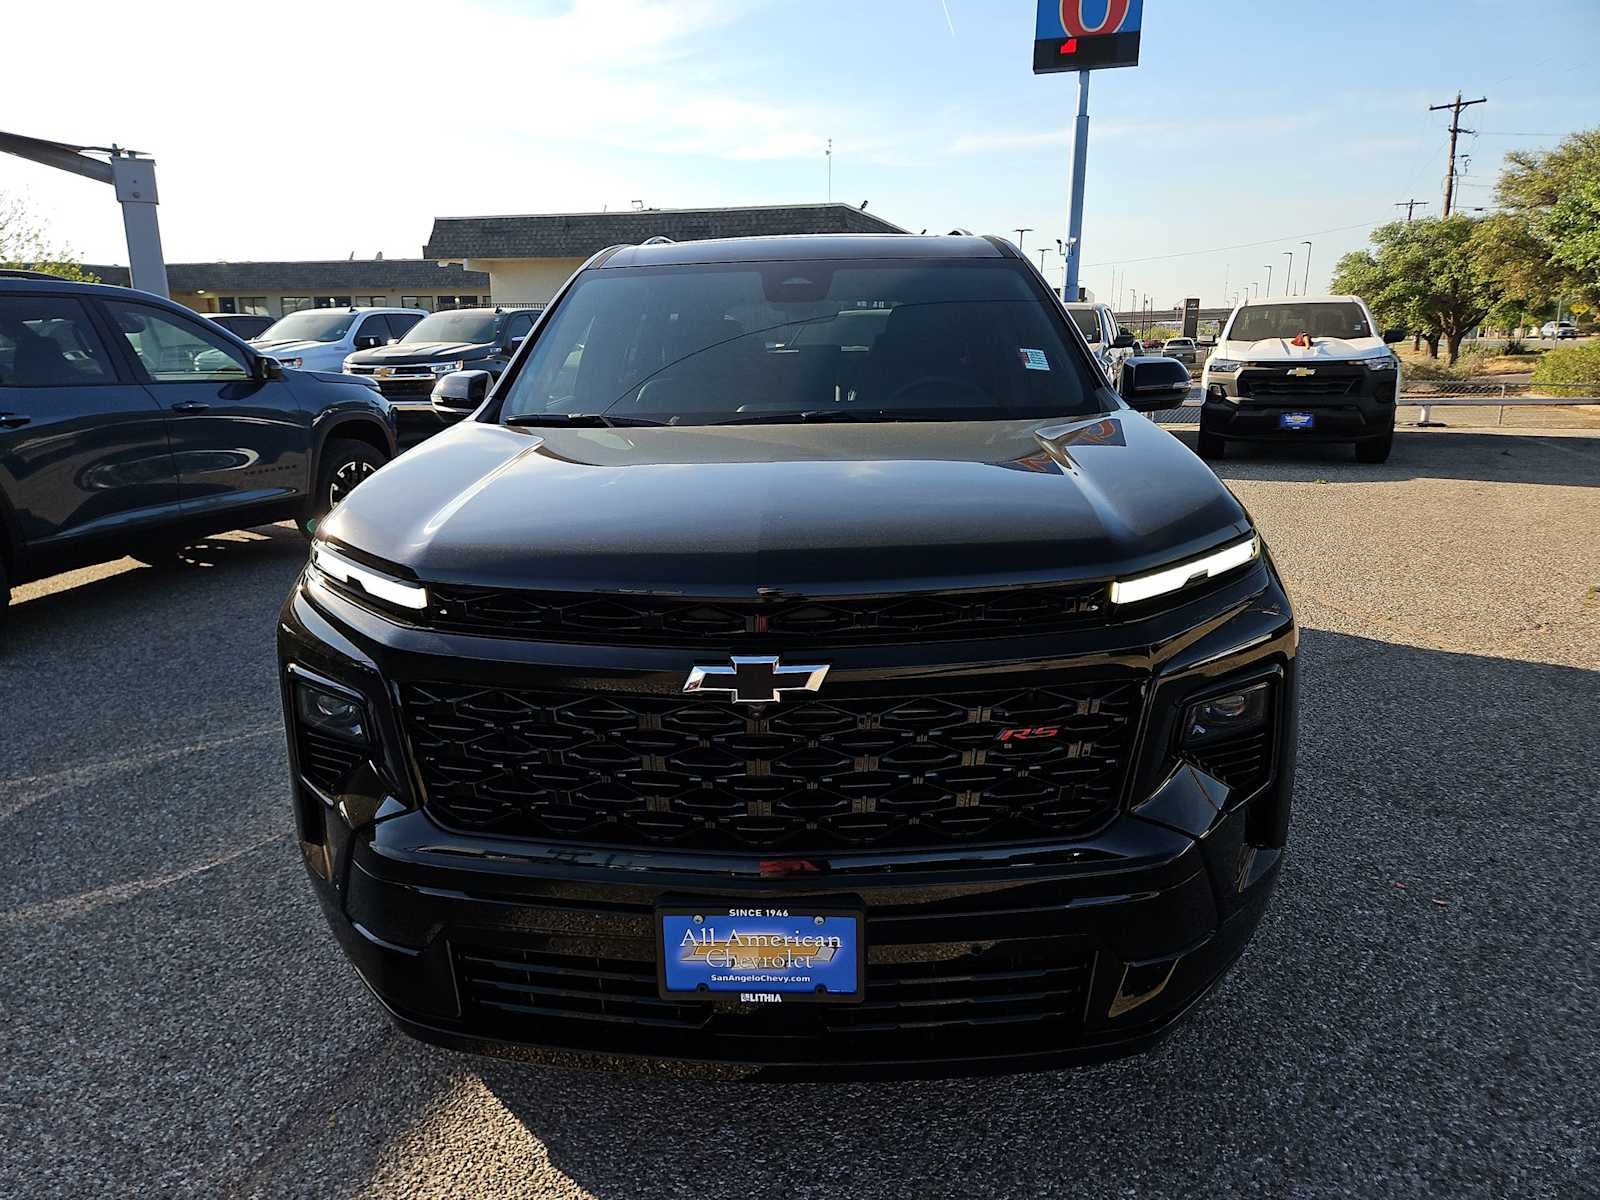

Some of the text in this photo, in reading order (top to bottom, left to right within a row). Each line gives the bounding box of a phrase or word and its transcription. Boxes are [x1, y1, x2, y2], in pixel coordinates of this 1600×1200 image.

[995, 727, 1060, 741] RS
[729, 909, 789, 917] SINCE 1946
[680, 928, 842, 948] All American
[706, 949, 814, 968] Chevrolet
[711, 974, 811, 983] SanAngeloChevy.com
